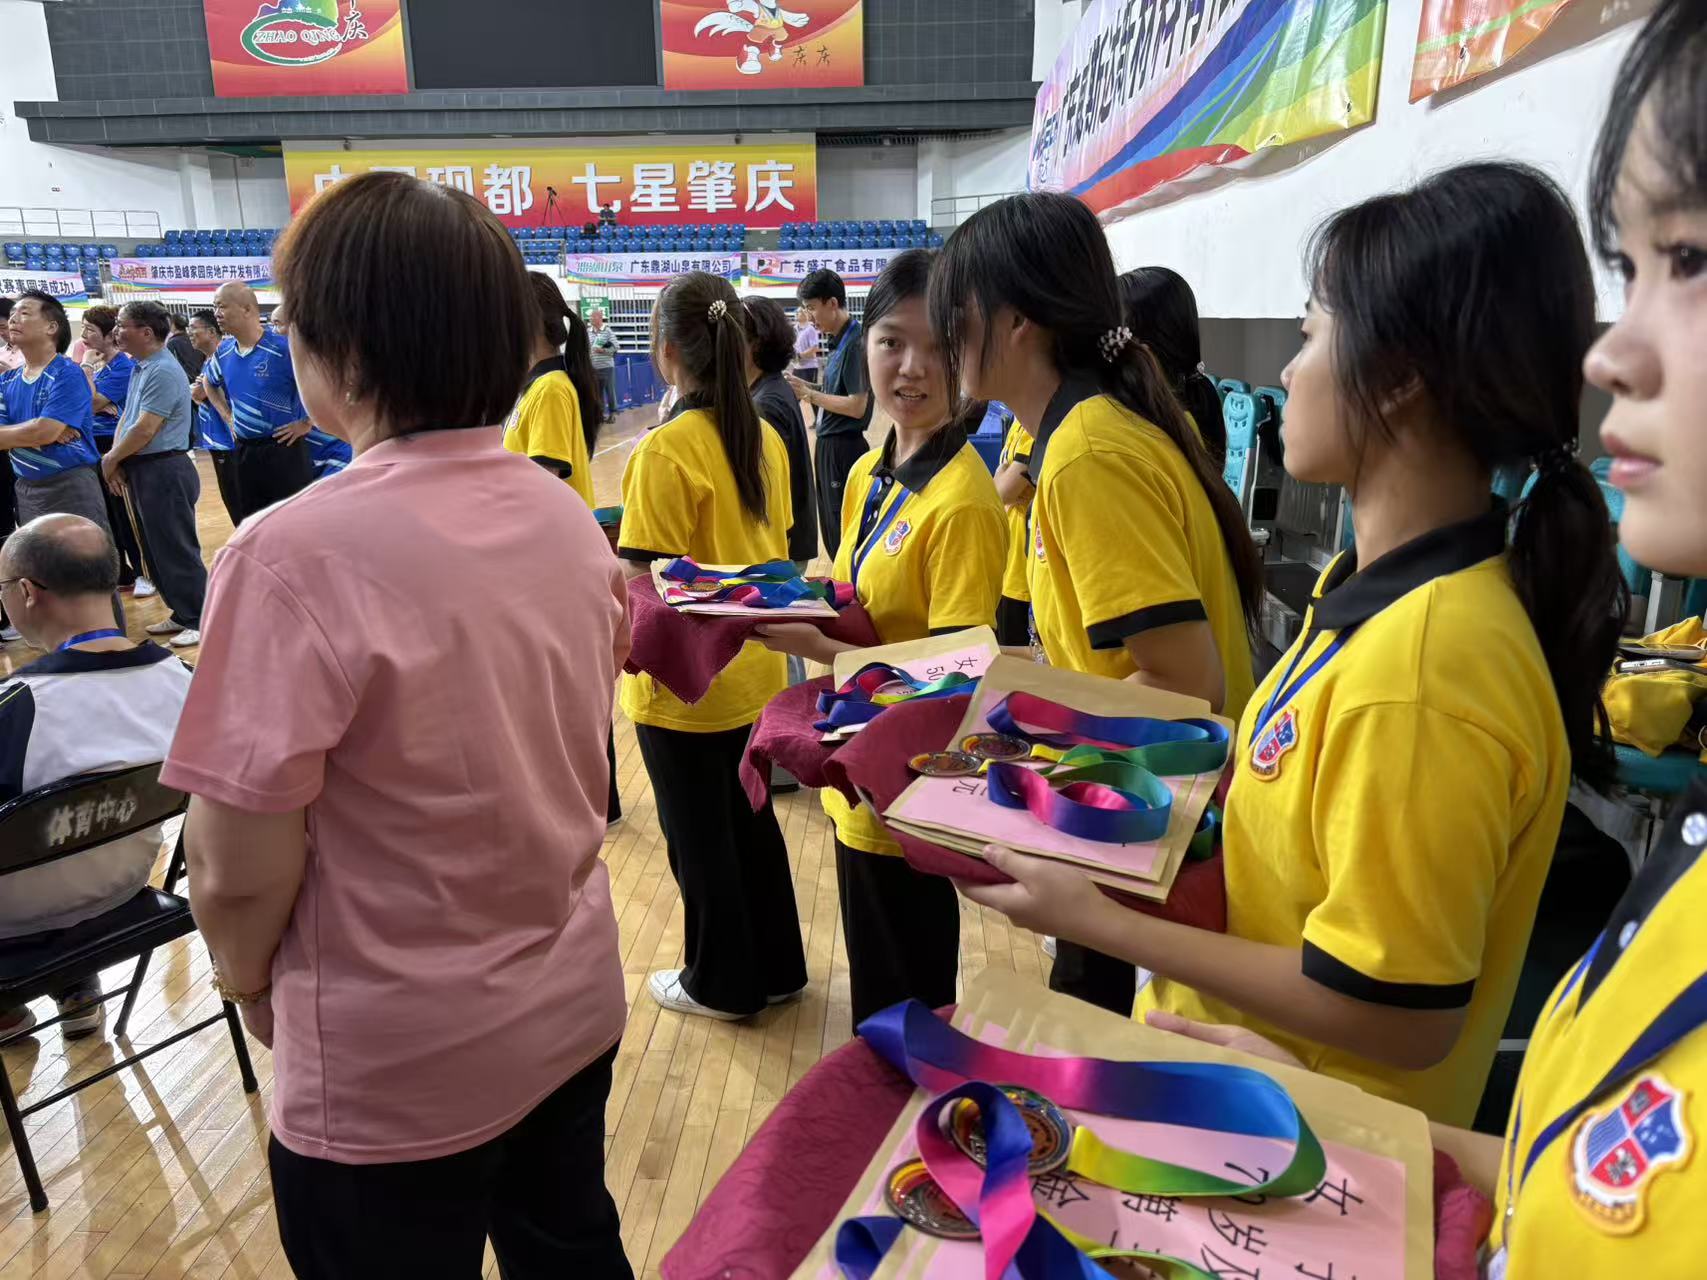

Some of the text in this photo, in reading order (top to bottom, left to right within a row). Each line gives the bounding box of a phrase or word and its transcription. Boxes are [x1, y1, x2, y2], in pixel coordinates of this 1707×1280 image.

[254, 29, 341, 46] ZHAO QING
[571, 160, 795, 215] 七星肇庆
[630, 259, 731, 274] 广东鼎湖山泉有限公司
[48, 788, 137, 848] 体育中心
